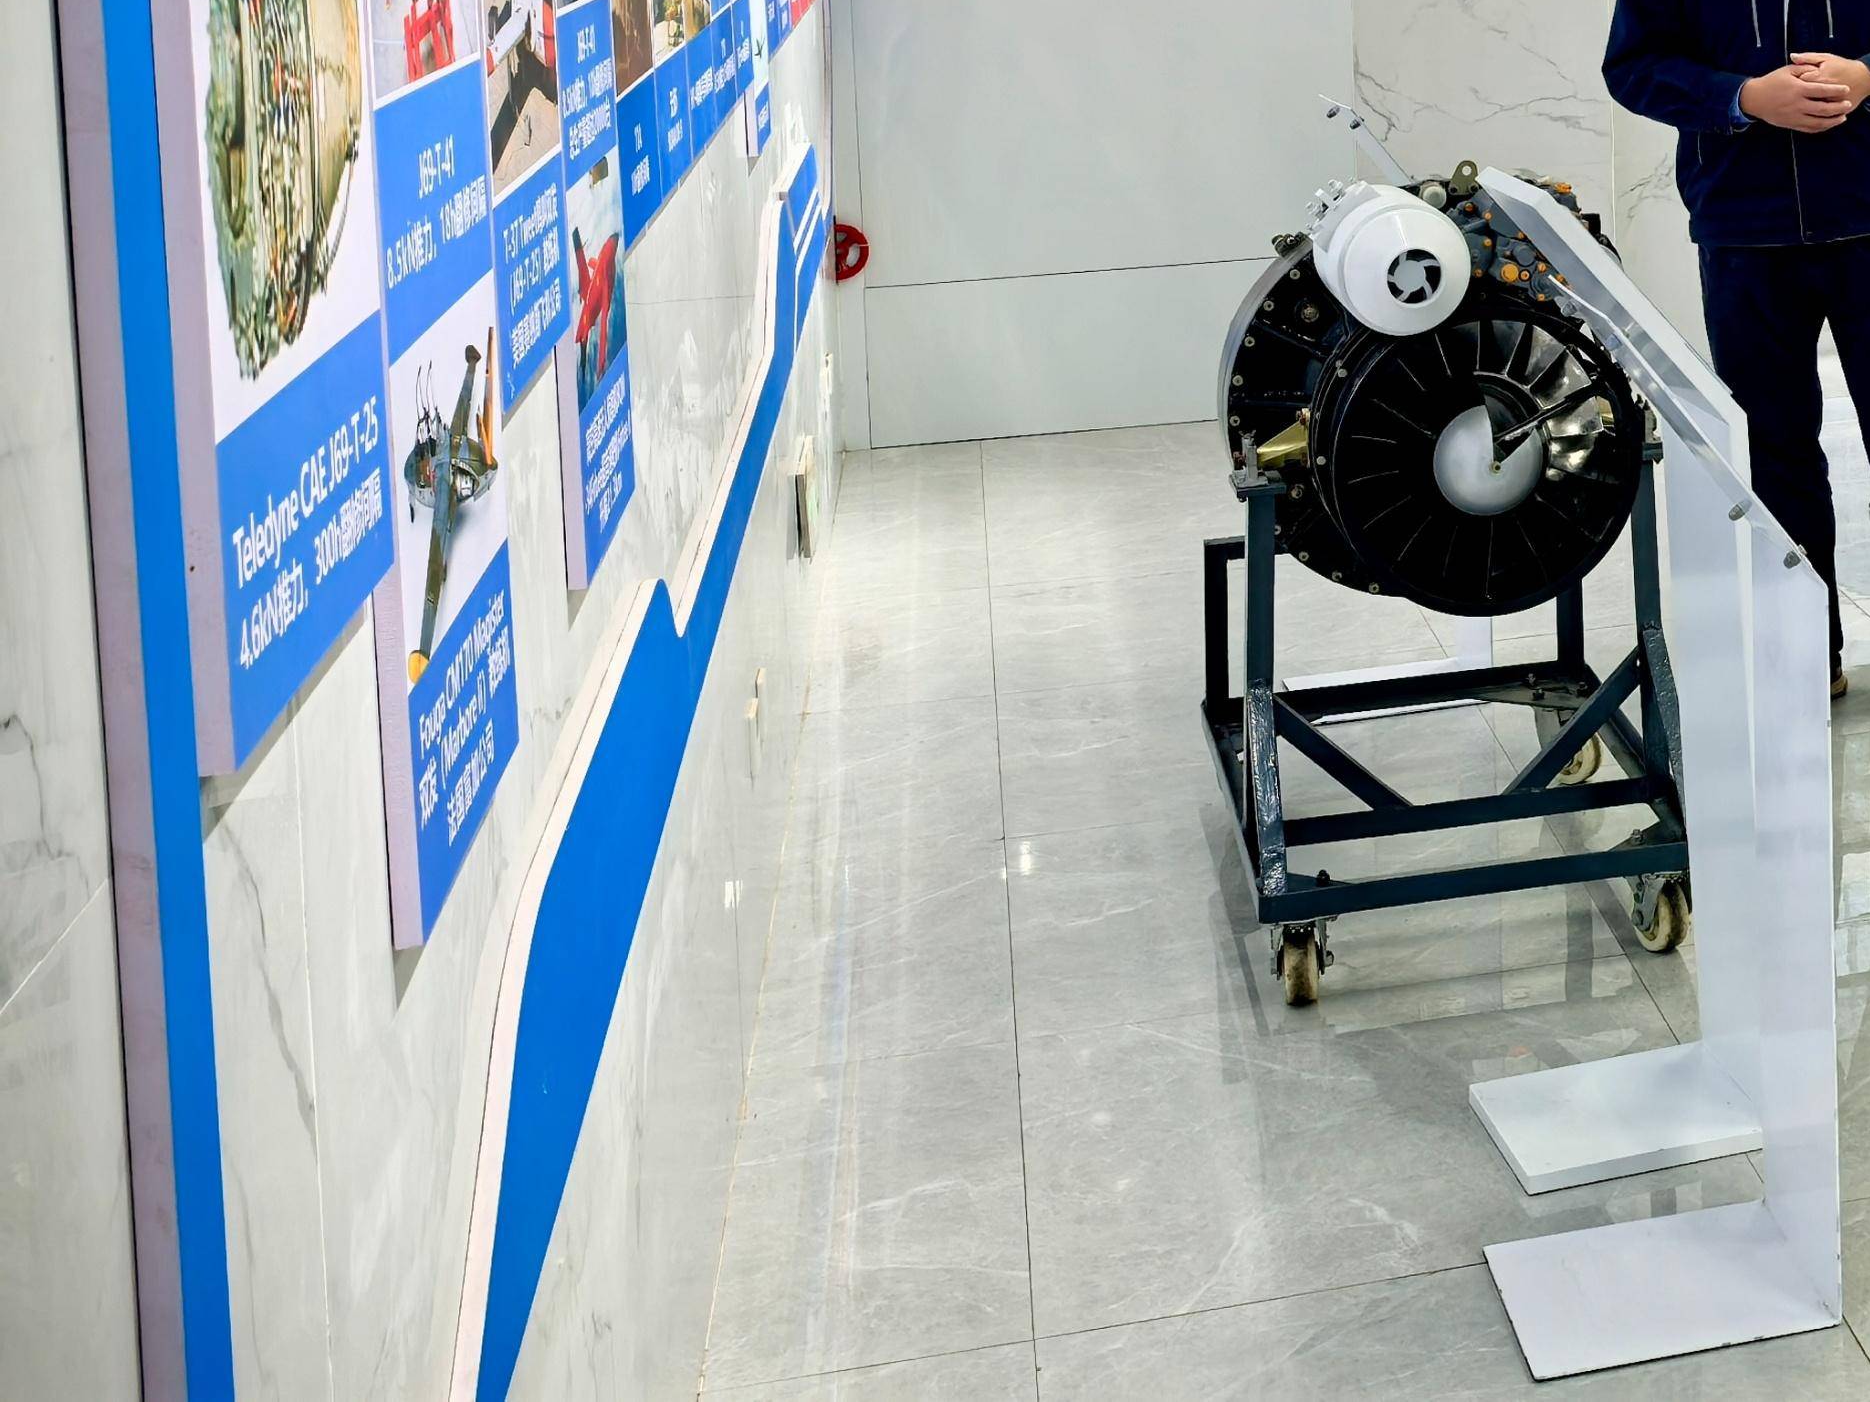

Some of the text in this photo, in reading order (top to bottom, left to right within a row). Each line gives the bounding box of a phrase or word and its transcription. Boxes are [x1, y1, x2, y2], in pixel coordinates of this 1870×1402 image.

[419, 133, 455, 198] J69-T-41
[233, 395, 378, 589] Teledyne CAE J69-T-25
[419, 588, 504, 761] Fouga CM170 Magister
